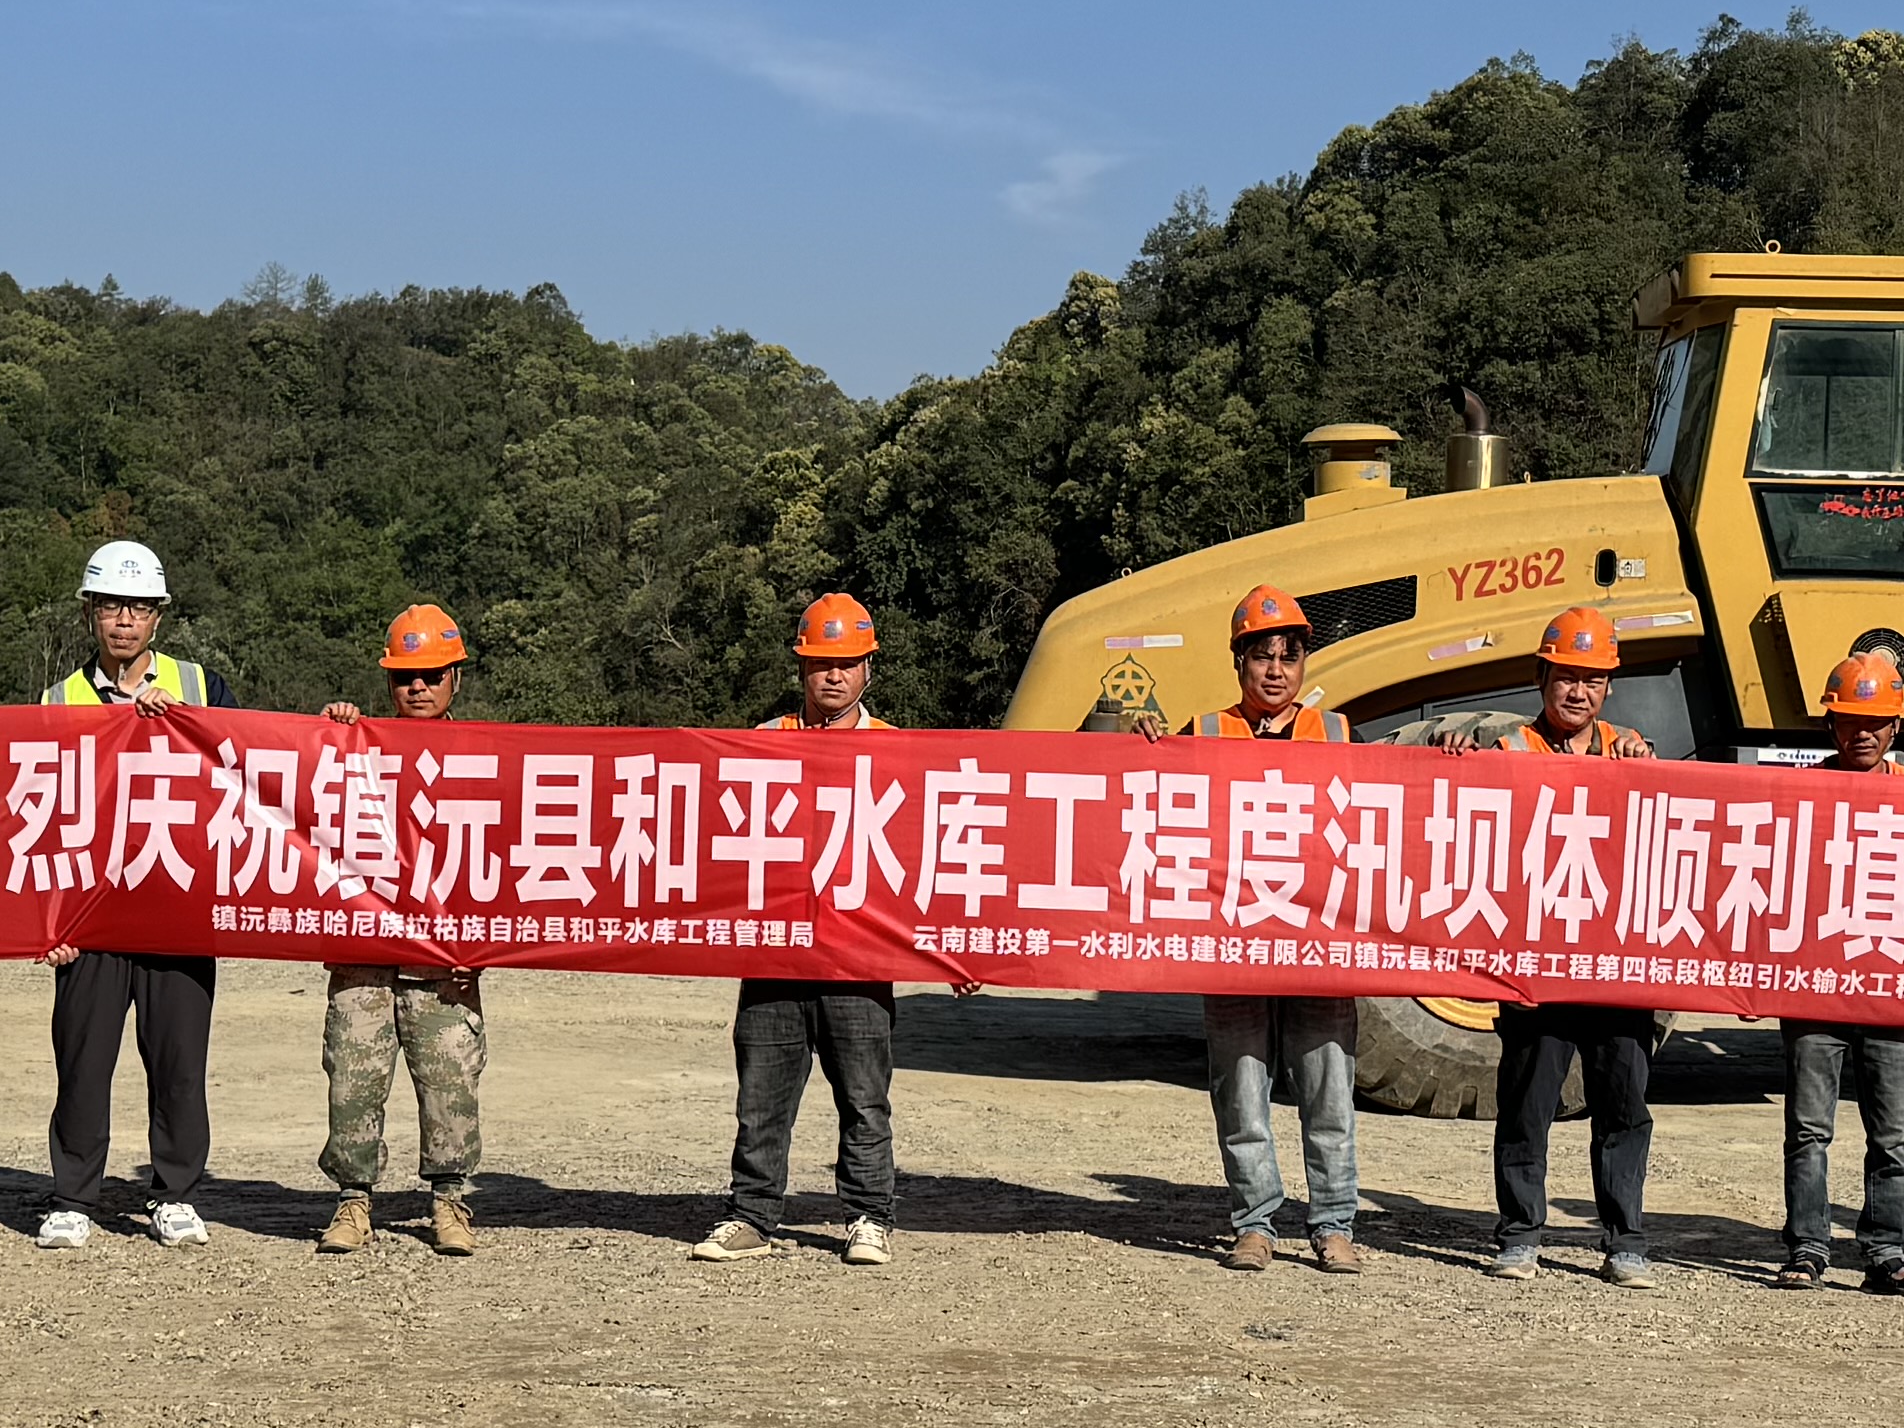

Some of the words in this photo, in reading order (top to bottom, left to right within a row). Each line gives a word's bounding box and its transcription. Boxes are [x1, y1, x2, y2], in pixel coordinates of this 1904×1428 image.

[1447, 547, 1565, 602] YZ362
[211, 903, 815, 949] 镇沅彝族哈尼族拉祜族自治县和平水库工程管理局
